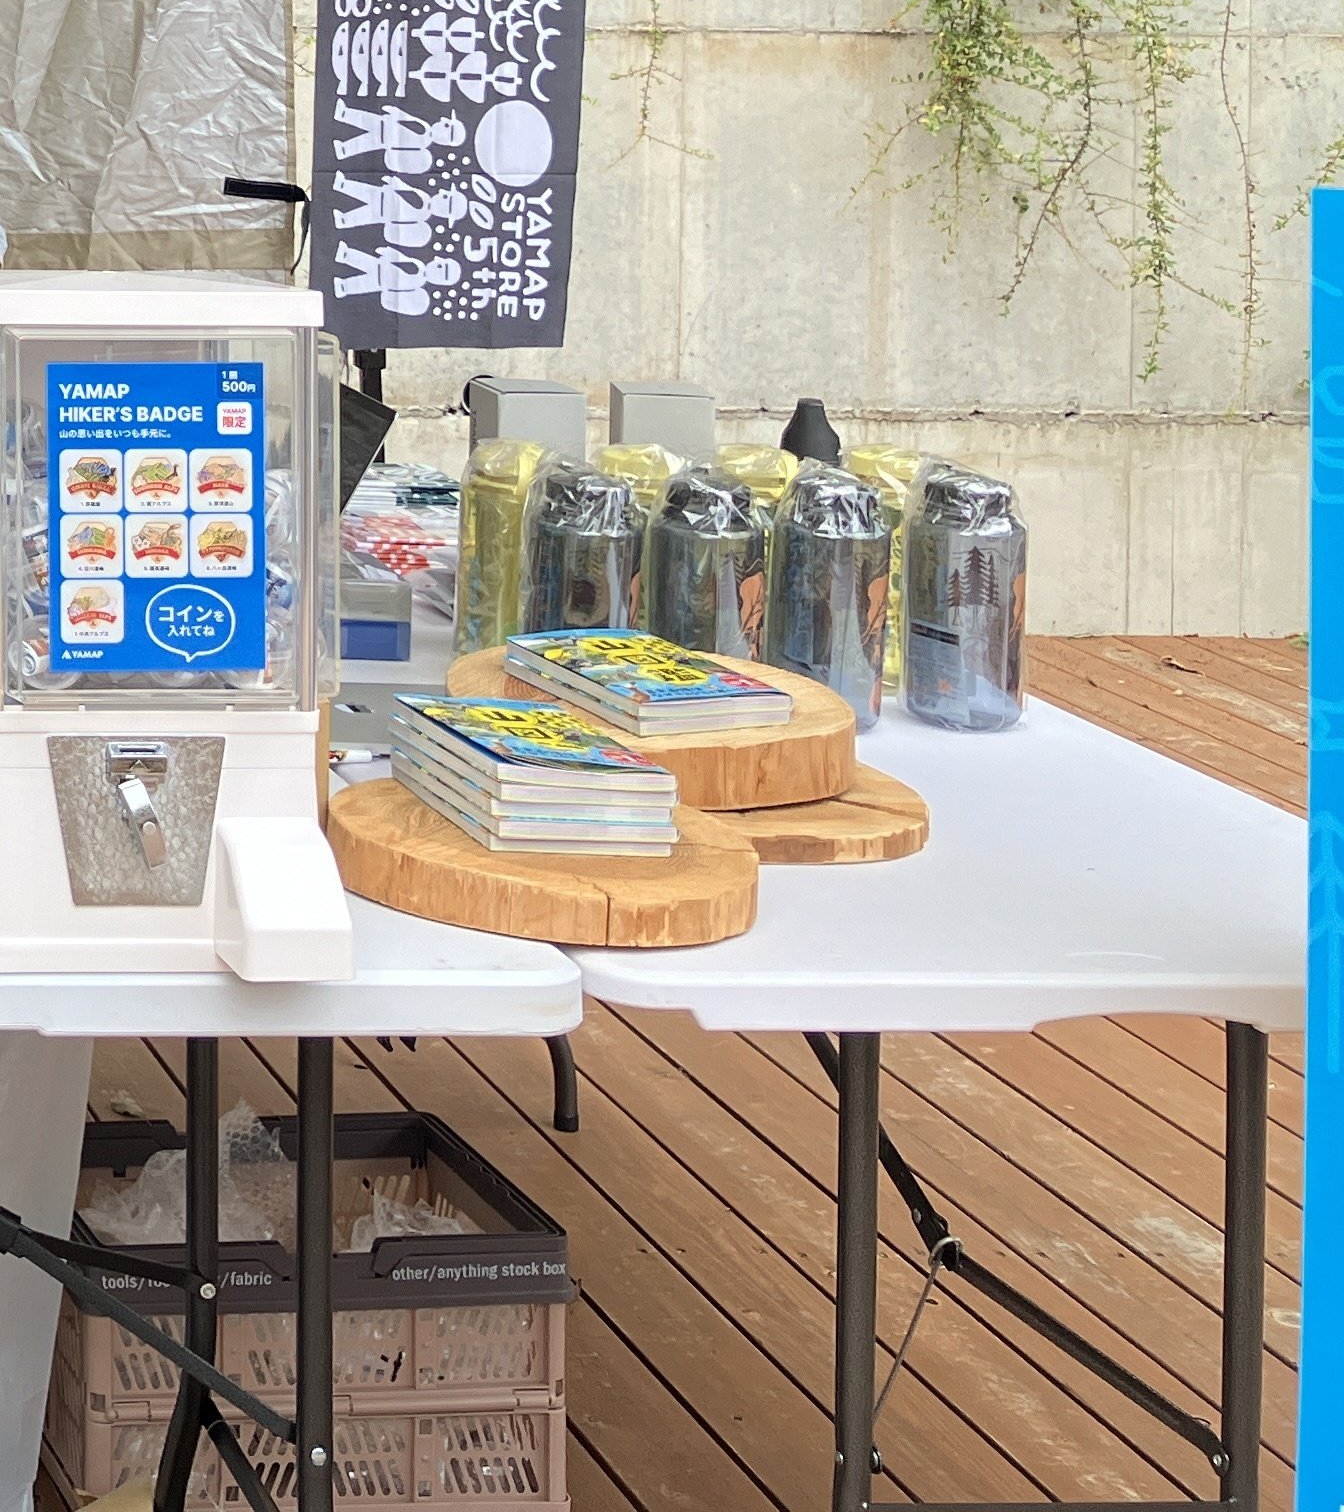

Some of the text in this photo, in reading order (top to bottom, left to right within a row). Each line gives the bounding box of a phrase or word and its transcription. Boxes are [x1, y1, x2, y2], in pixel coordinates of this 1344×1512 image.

[497, 193, 525, 317] STORE
[523, 188, 552, 320] YAMAP
[58, 383, 130, 400] YAMAP
[221, 381, 256, 393] 500円
[59, 406, 203, 423] HIKER'S BADGE
[222, 416, 247, 428] 限定
[158, 604, 225, 623] コインを
[167, 625, 215, 637] 入れてね
[72, 649, 104, 659] YAMAP
[392, 1260, 566, 1283] other/anything stock box
